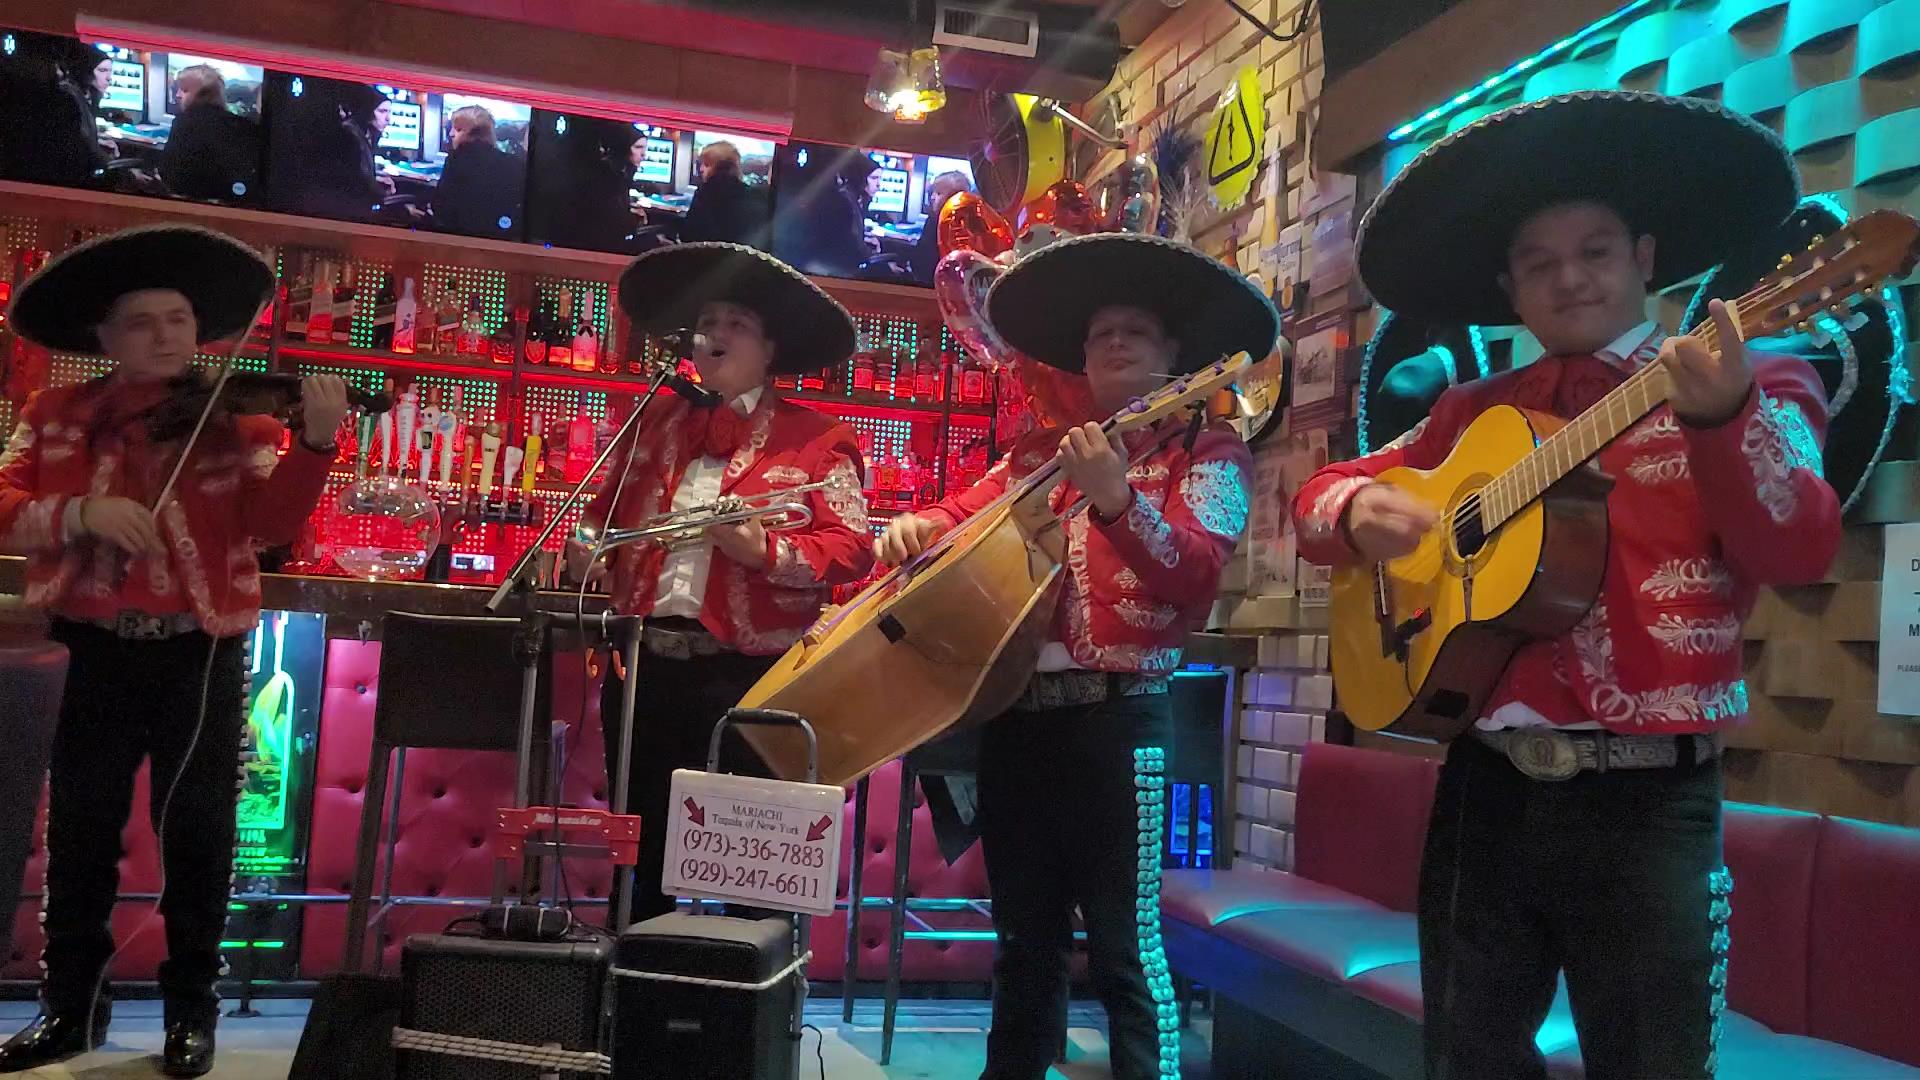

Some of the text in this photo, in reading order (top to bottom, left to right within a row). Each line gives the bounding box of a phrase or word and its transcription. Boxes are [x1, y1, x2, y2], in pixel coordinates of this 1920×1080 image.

[732, 804, 783, 821] MARIACHI
[745, 820, 755, 830] of
[757, 820, 776, 831] New
[779, 826, 800, 836] York
[683, 828, 825, 869] (973)-336-7883
[680, 858, 819, 899] (929)-247-6611
